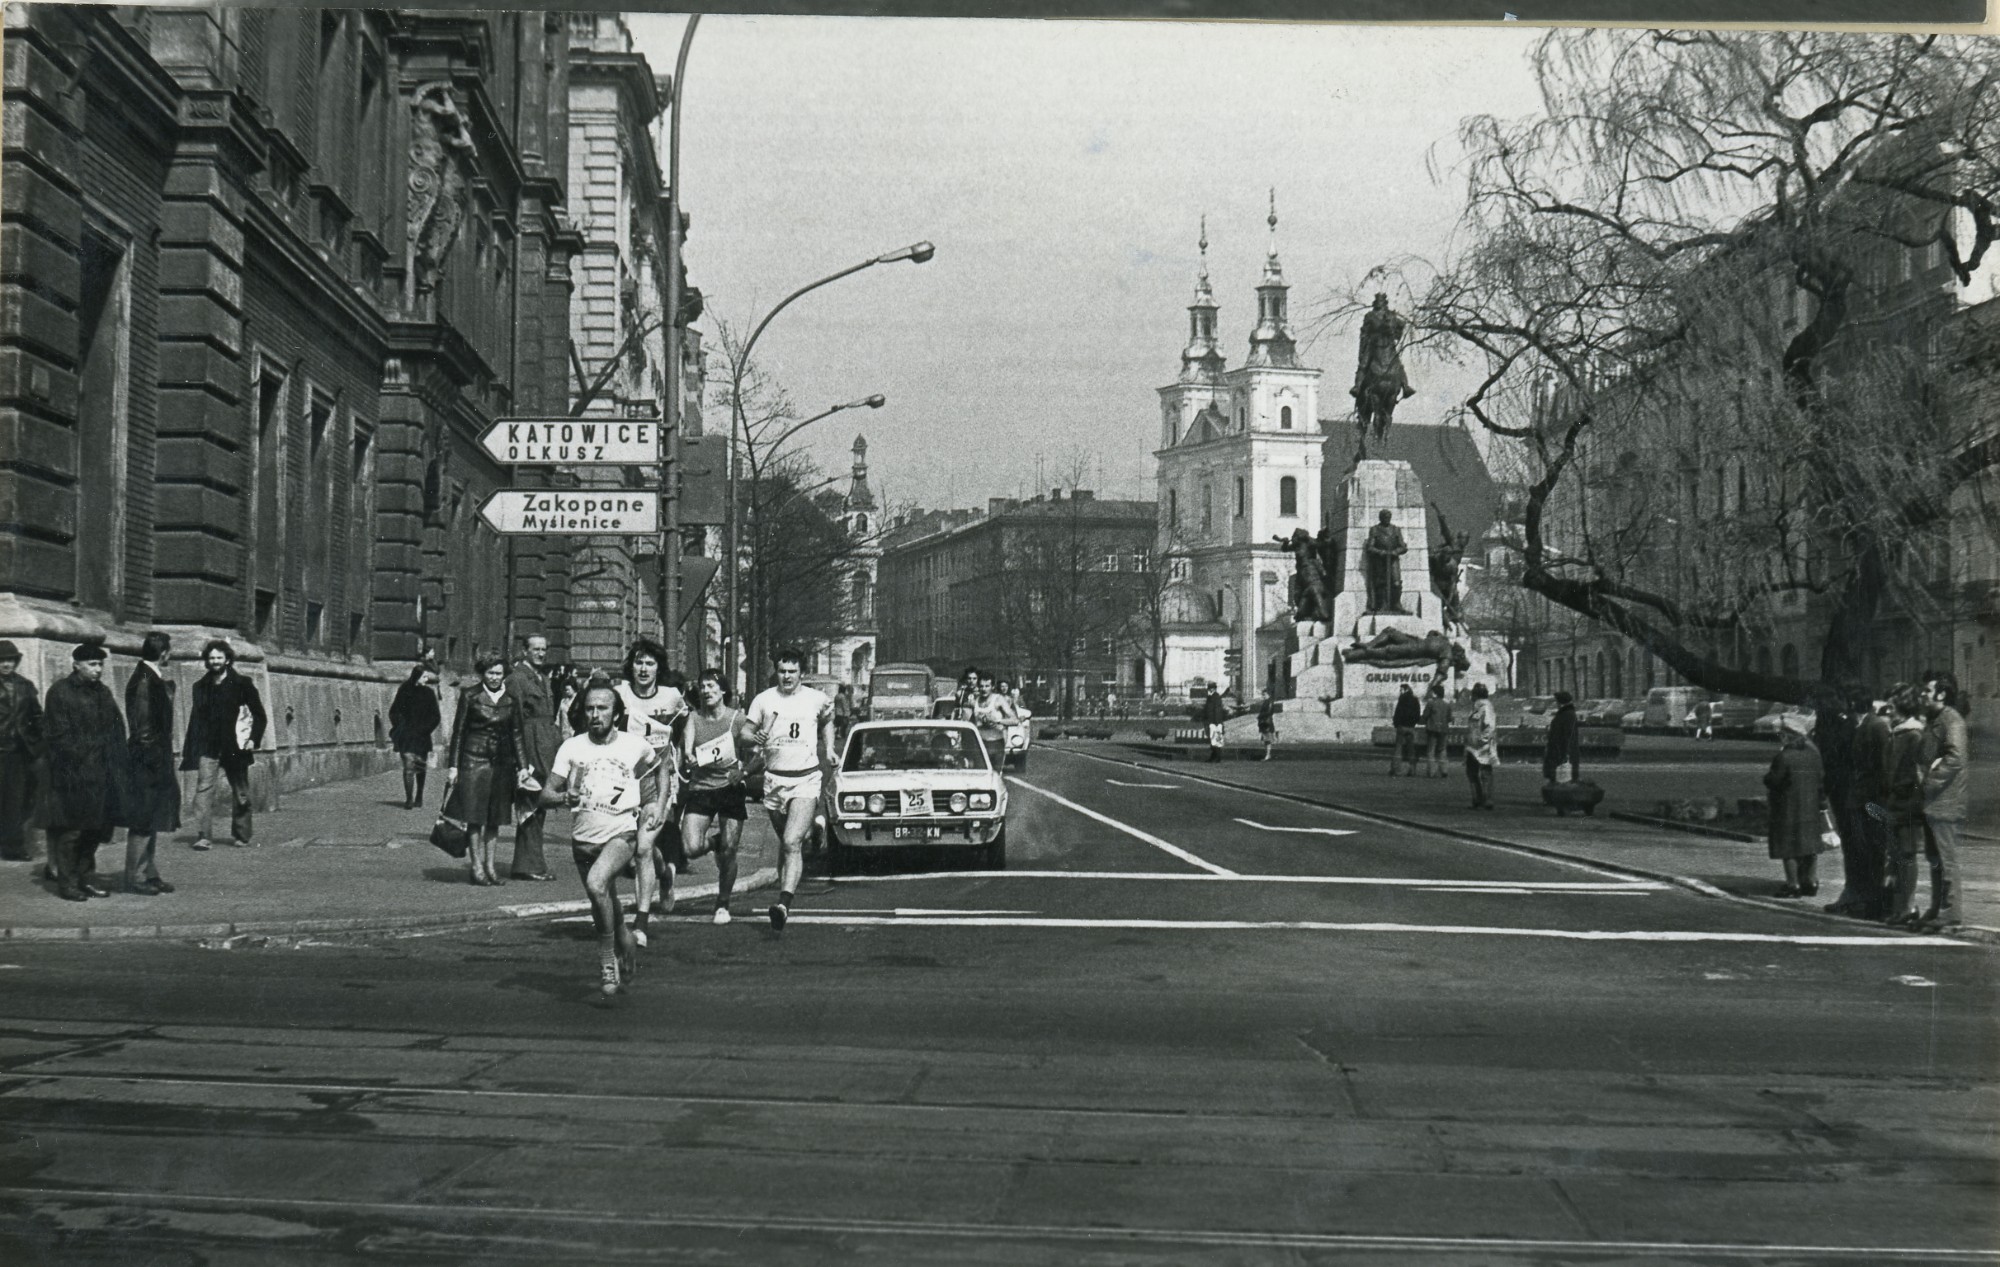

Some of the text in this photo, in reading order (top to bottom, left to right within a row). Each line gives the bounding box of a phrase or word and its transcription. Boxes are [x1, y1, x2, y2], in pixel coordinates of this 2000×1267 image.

[508, 424, 649, 444] KATOWICE
[508, 446, 604, 460] OLKUSZ
[522, 494, 644, 516] Zakopane
[522, 514, 622, 532] Myślenice
[1365, 672, 1431, 683] GRUNWALD
[788, 722, 800, 739] 8
[711, 747, 723, 763] 2
[610, 785, 625, 805] 7
[908, 793, 925, 807] 25
